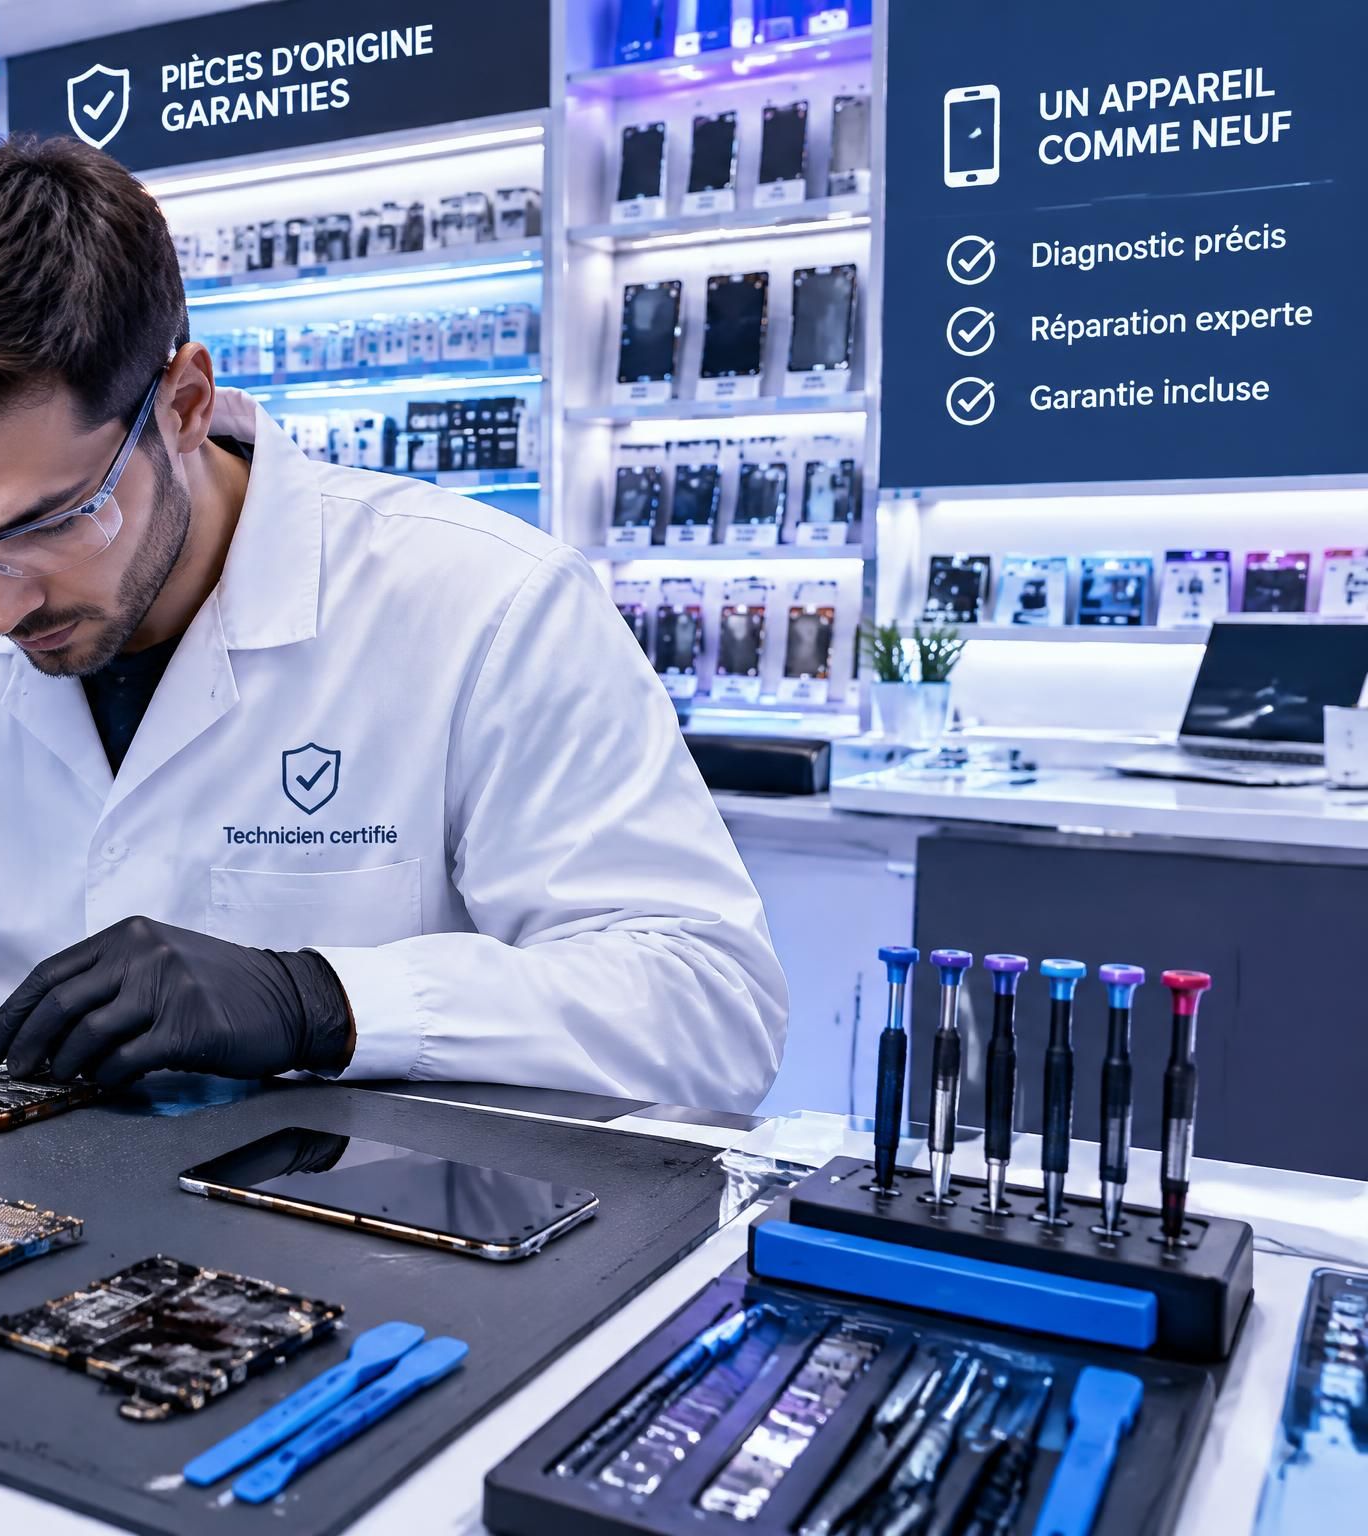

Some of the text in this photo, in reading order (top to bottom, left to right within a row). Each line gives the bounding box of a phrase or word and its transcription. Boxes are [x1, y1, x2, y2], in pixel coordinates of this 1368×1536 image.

[161, 24, 434, 93] PIÈCES D'ORIGINE
[161, 77, 350, 132] GARANTIES
[1039, 67, 1276, 121] UN APPAREIL
[1038, 110, 1292, 165] COMME NEUF
[1032, 223, 1287, 271] Diagnostic précis
[1031, 302, 1313, 346] Réparation experte
[1030, 376, 1270, 411] Garantie incluse
[222, 824, 398, 845] Technicien certifié
